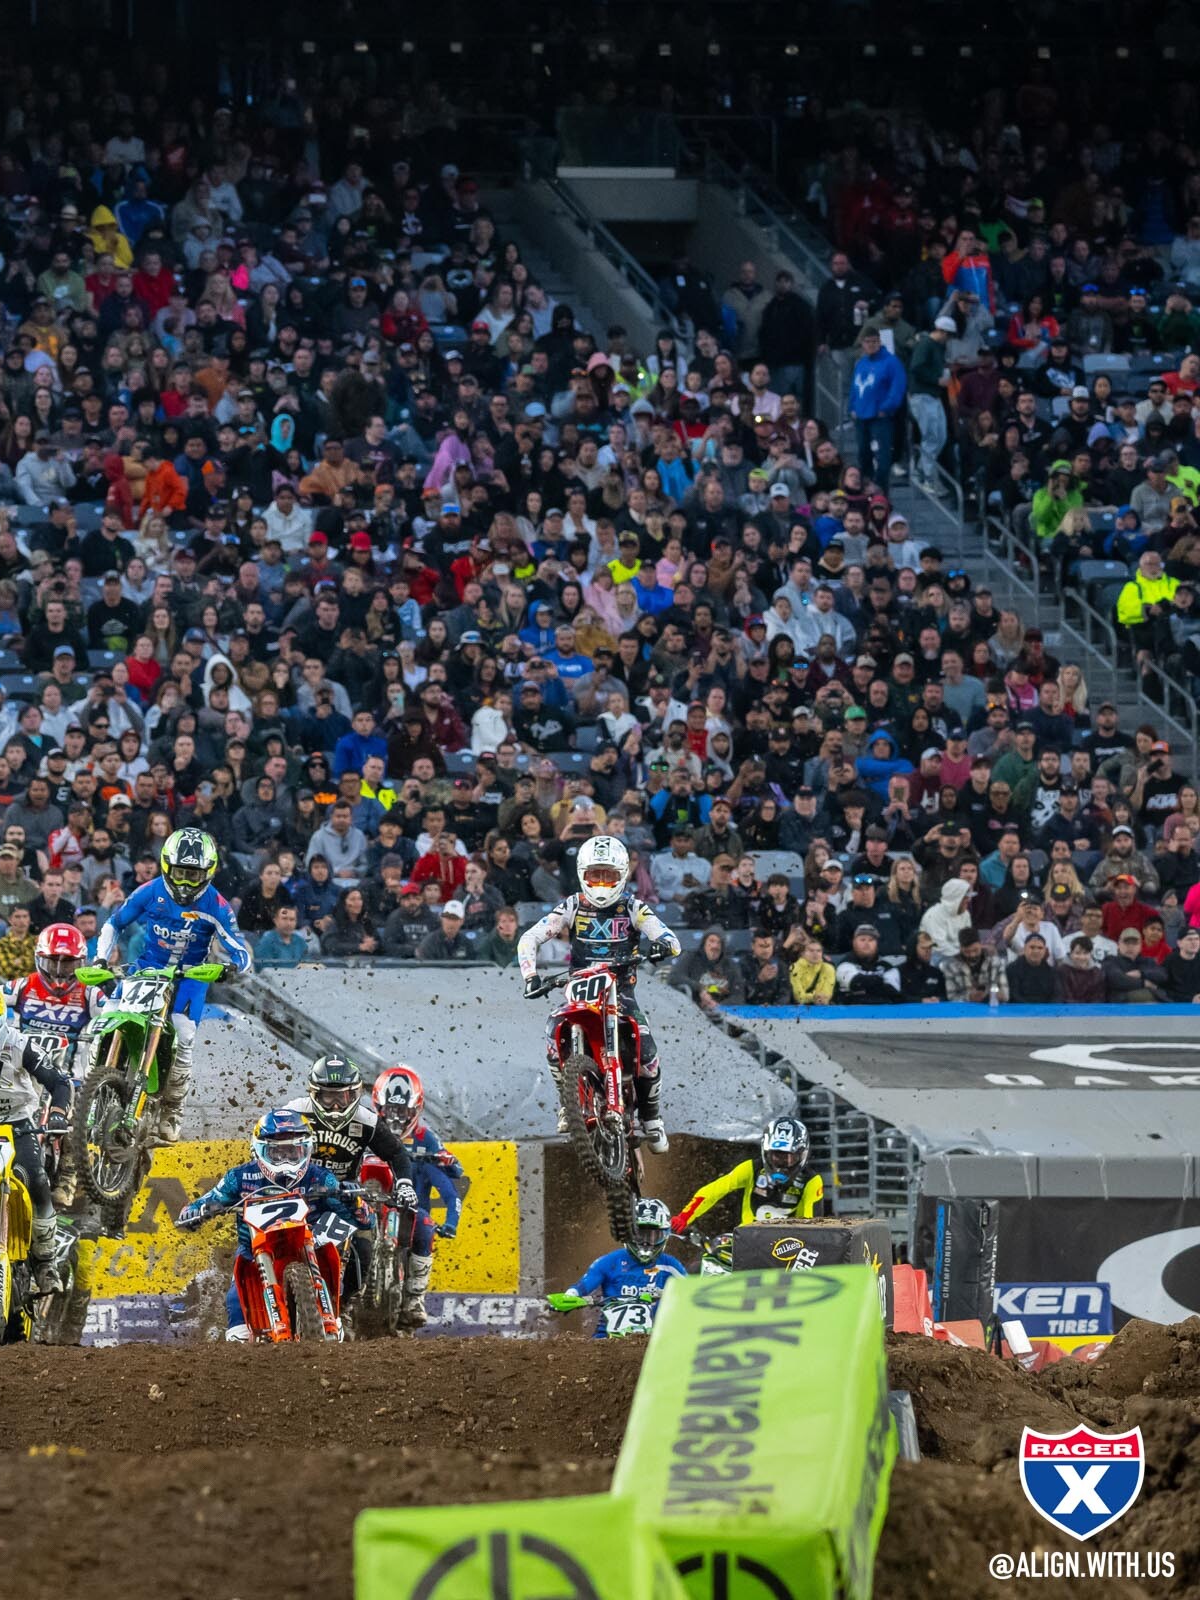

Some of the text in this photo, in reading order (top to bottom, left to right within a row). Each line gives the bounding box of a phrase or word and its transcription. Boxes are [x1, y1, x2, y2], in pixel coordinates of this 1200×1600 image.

[576, 917, 631, 938] FXR
[125, 981, 166, 1005] 47
[571, 974, 607, 1002] 60
[24, 998, 85, 1022] FXR
[29, 1019, 71, 1032] MOTO
[310, 1130, 362, 1156] STHOUSE
[260, 1202, 295, 1231] 2
[942, 1229, 953, 1299] CHAMPIONSHIP
[994, 1287, 1104, 1314] KEN
[612, 1304, 647, 1331] 73
[1048, 1318, 1099, 1335] TIRES
[663, 1319, 804, 1517] Kawasaki
